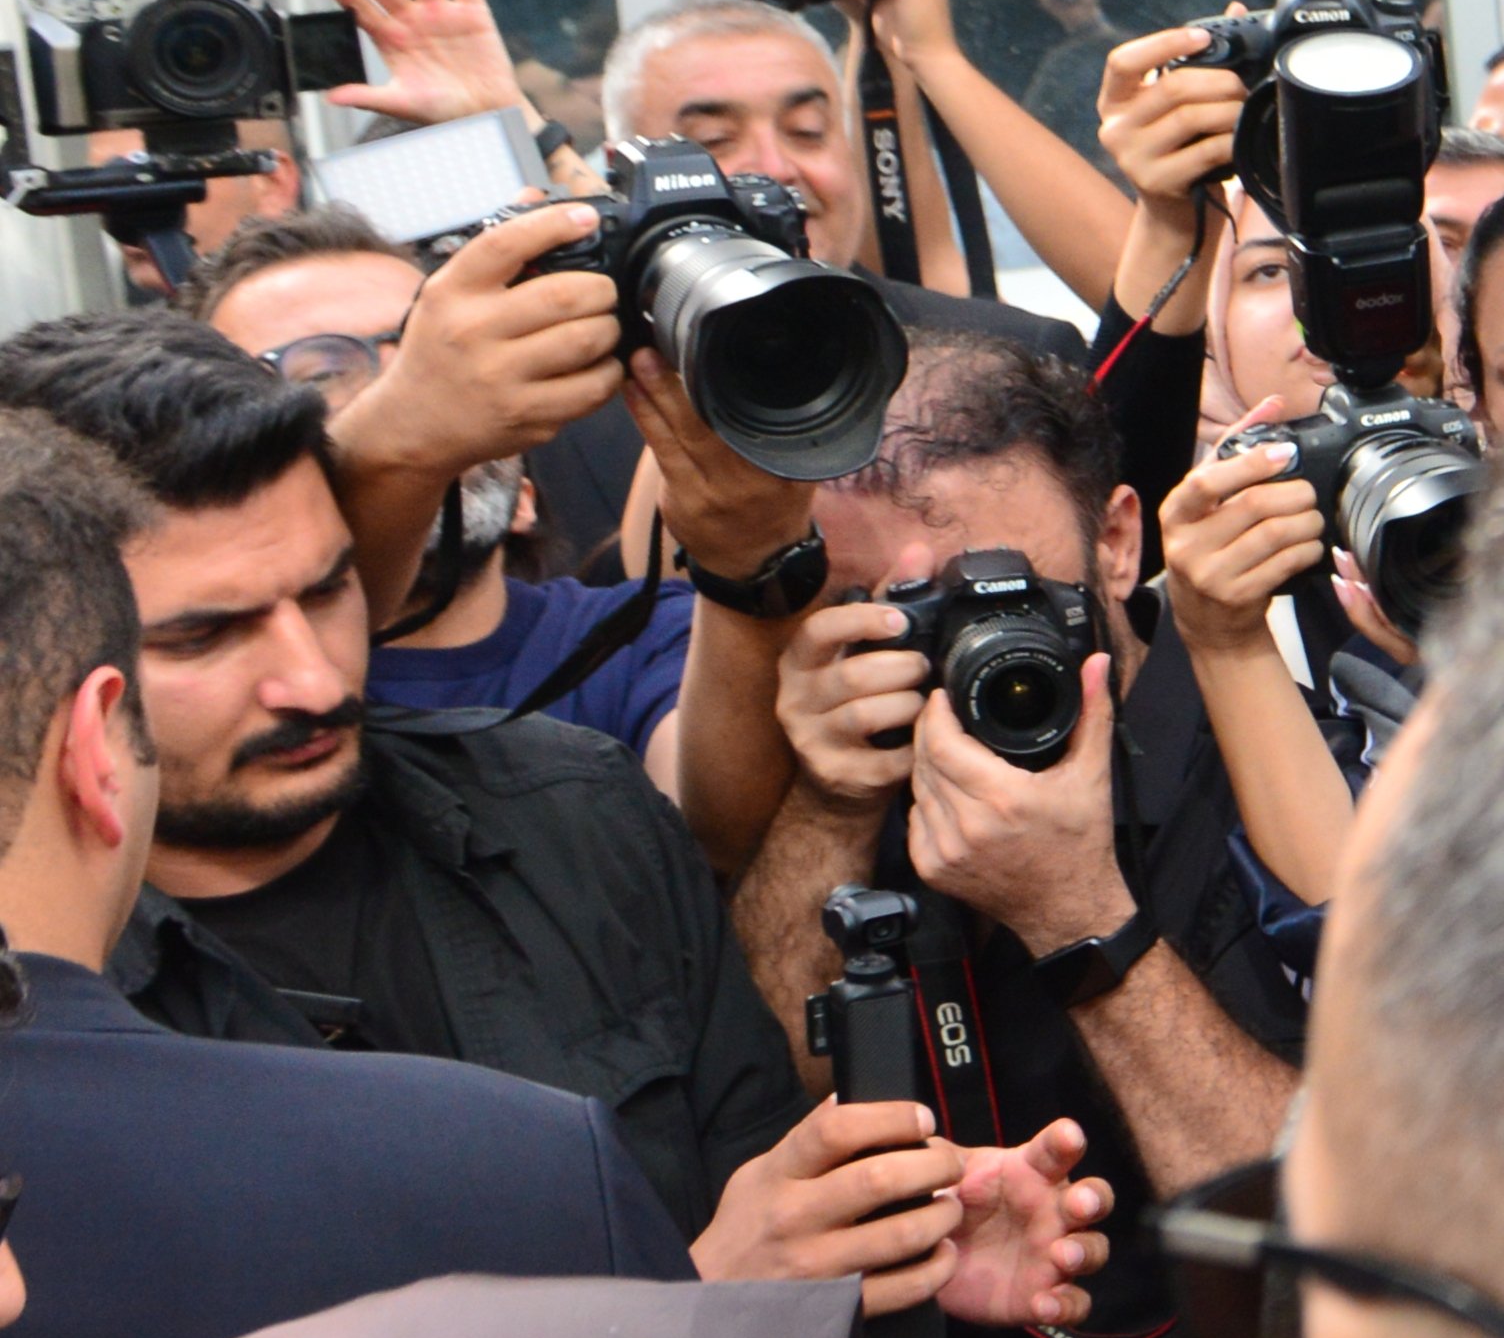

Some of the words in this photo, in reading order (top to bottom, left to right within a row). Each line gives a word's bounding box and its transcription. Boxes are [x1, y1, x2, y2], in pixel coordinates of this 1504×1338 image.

[1294, 9, 1350, 23] Canon
[654, 173, 716, 192] Nikon
[873, 127, 907, 223] SONY
[1360, 409, 1412, 427] Canon
[1442, 420, 1464, 434] EOS
[973, 578, 1027, 594] Canon
[936, 1001, 972, 1067] EOS
